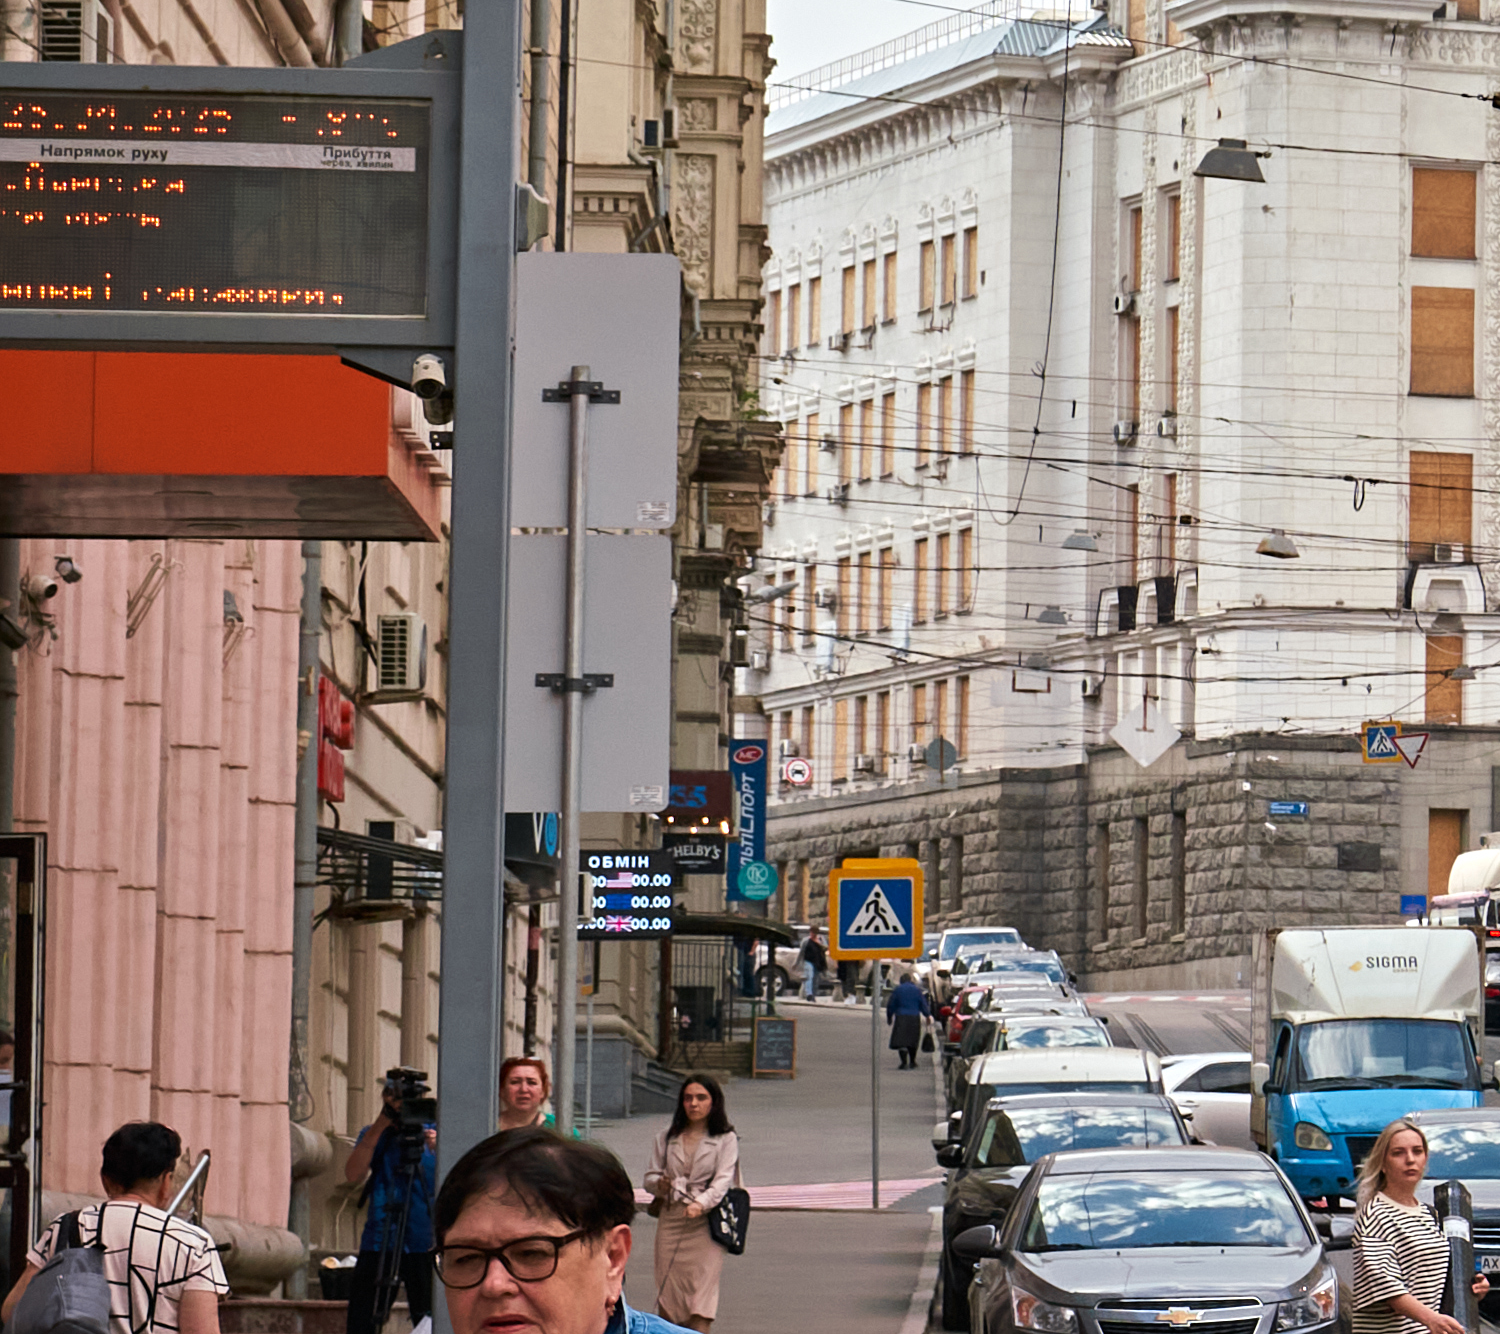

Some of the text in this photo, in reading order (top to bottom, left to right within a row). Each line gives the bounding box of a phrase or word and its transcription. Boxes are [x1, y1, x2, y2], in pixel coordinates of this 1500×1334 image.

[41, 144, 168, 162] Напрямок руху
[323, 146, 391, 160] Прибуття
[666, 845, 721, 860] HELBY'S
[588, 855, 650, 868] ОБМІН
[632, 874, 671, 887] 00.00
[631, 895, 671, 909] 00.00
[631, 917, 671, 930] 00.00
[1366, 956, 1418, 969] SIGMA
[1482, 1257, 1499, 1269] AX
